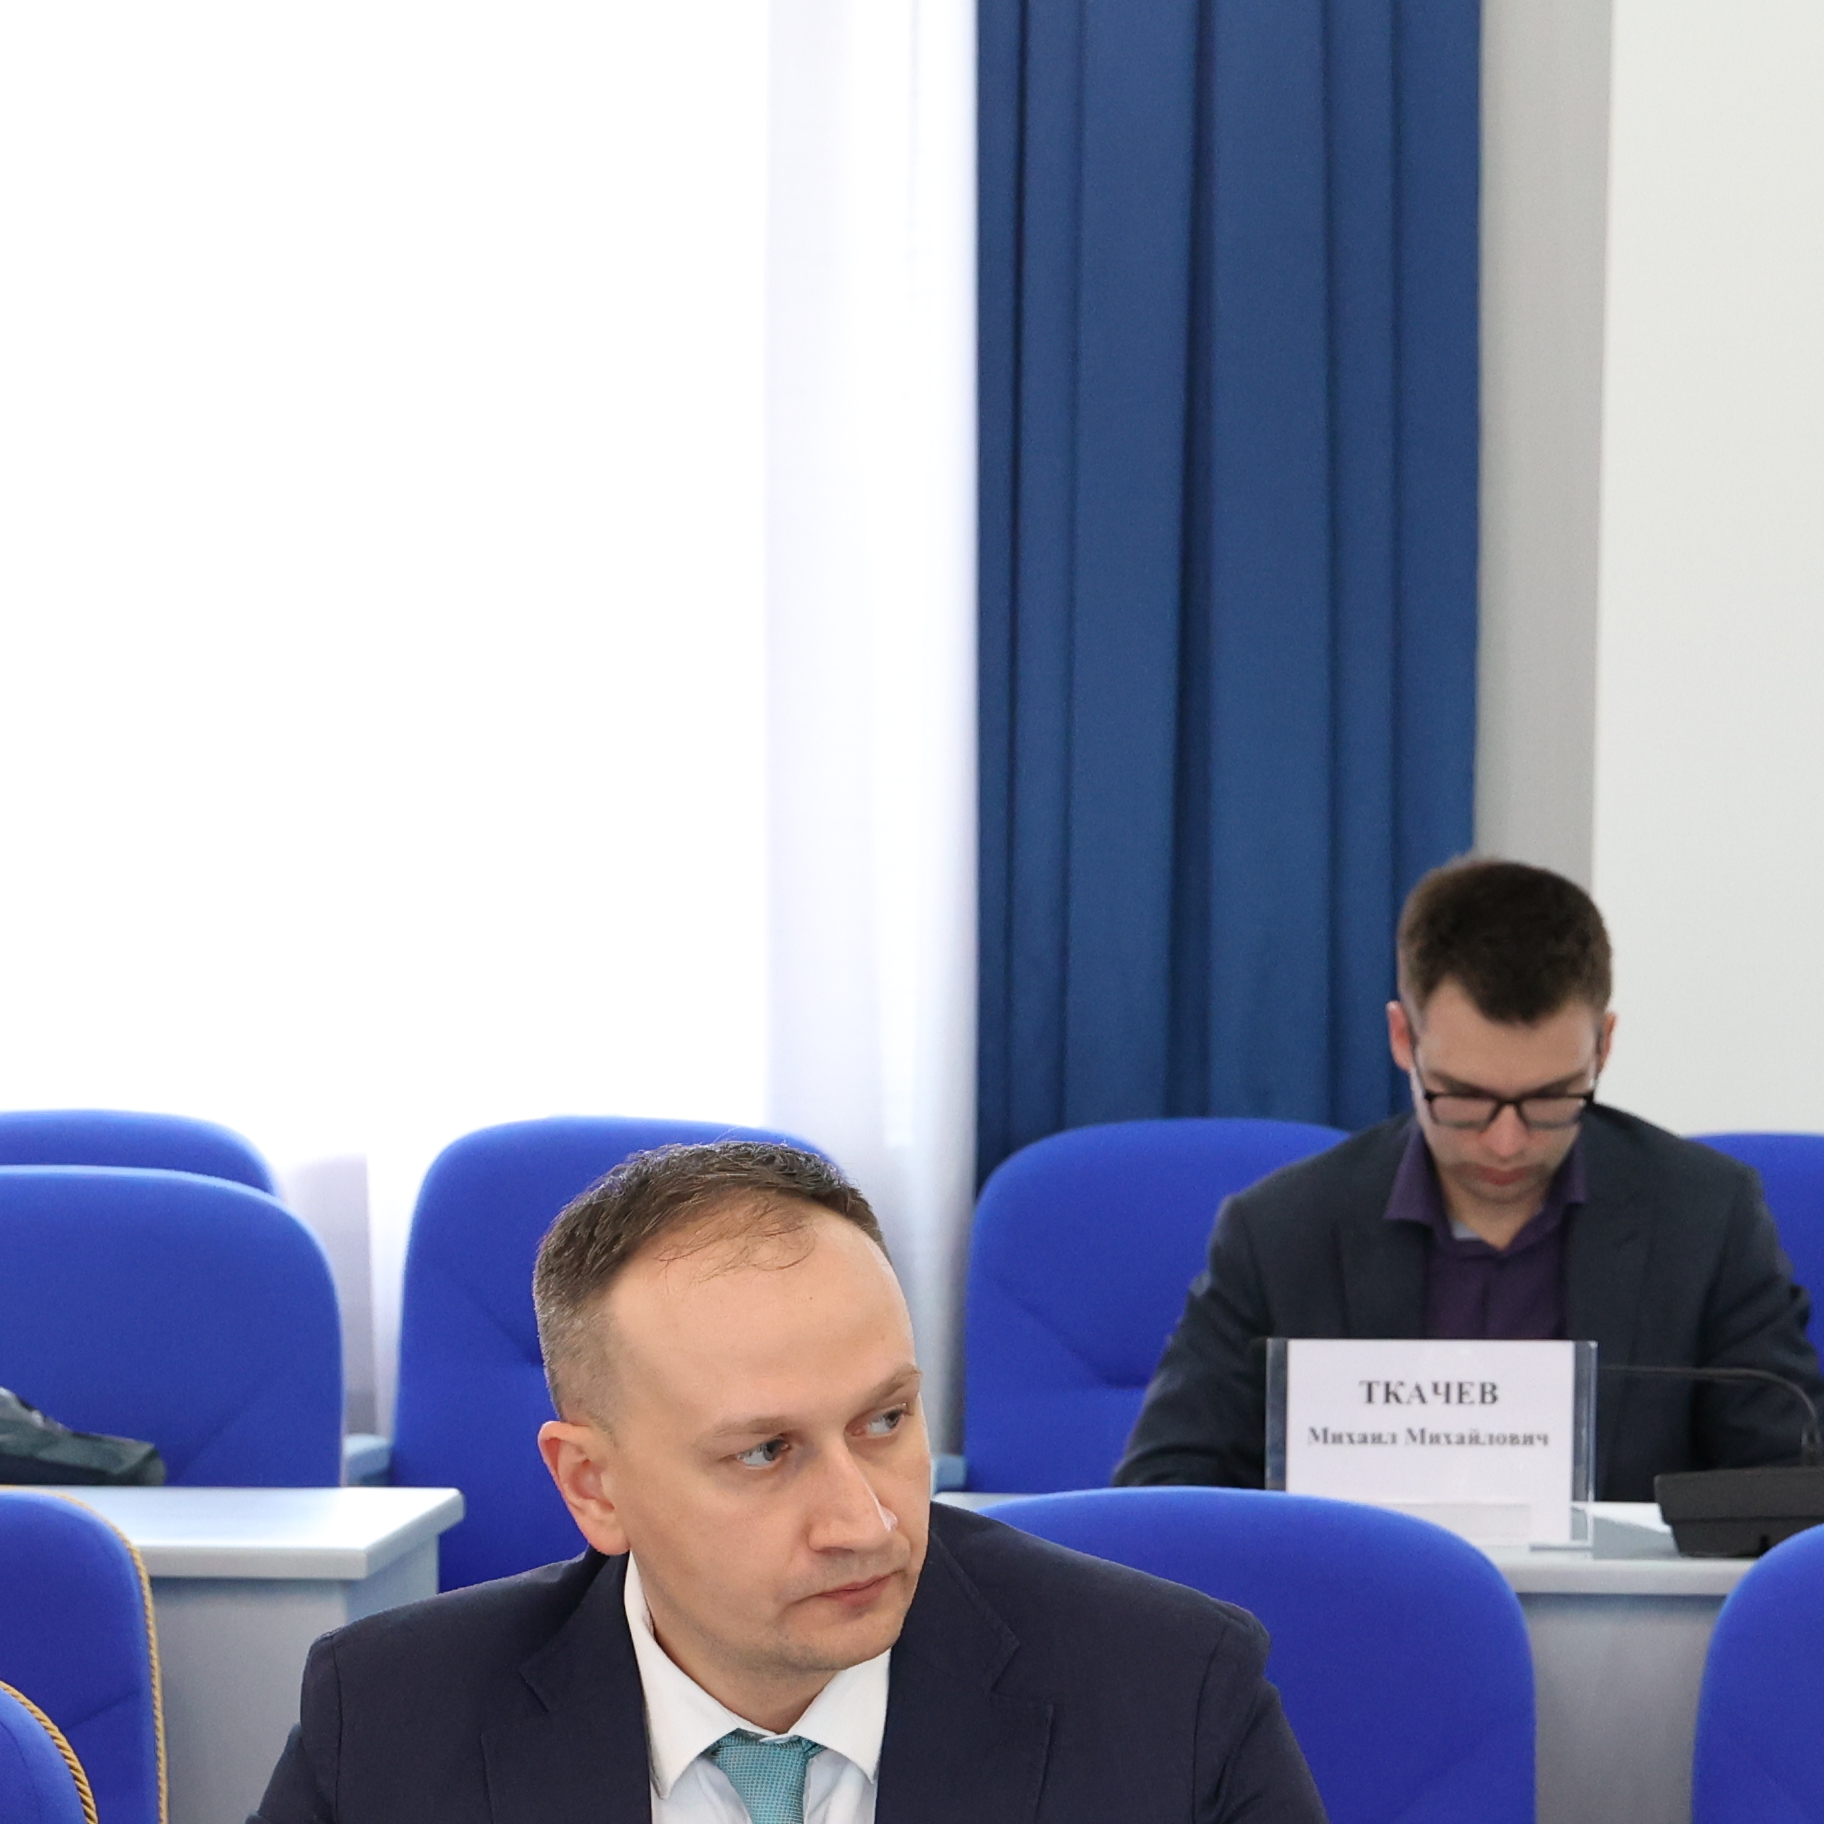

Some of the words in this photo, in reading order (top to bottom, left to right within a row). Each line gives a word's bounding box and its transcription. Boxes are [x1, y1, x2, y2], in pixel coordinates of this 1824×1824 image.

[1360, 1379, 1499, 1406] ТКАЧЕВ
[1308, 1426, 1398, 1447] Михаил
[1405, 1425, 1550, 1447] Михайлович
